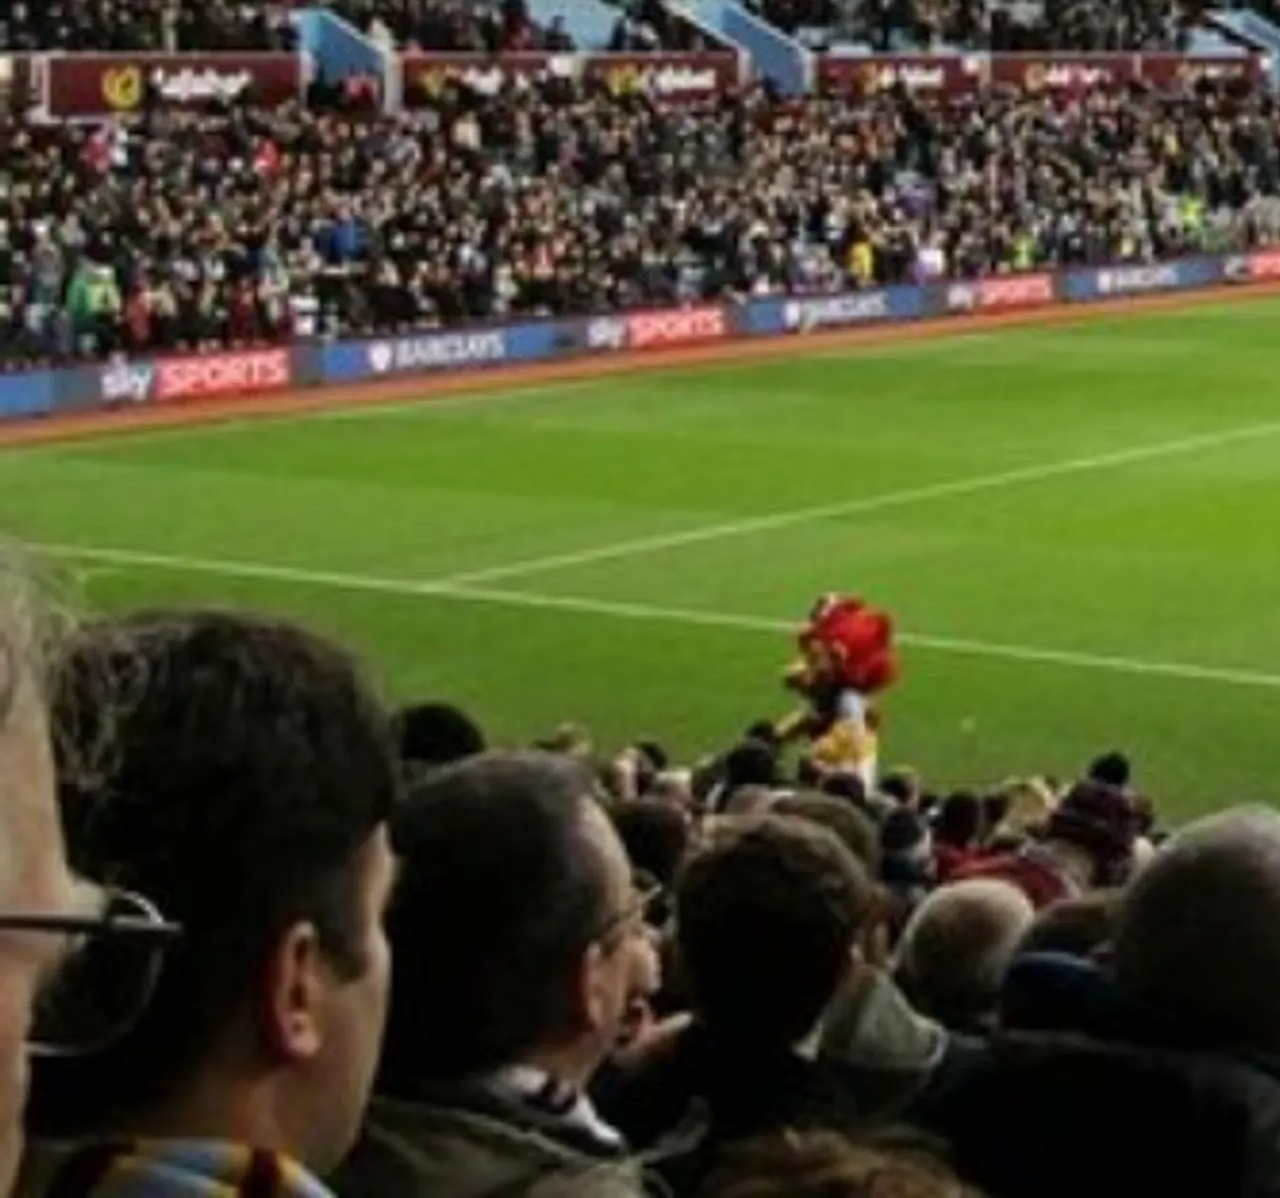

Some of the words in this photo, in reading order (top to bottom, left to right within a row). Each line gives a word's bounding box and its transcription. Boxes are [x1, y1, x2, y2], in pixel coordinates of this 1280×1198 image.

[629, 308, 725, 346] SPORTS
[396, 330, 506, 368] BARCLAYS
[102, 352, 152, 401] sky
[156, 350, 288, 400] SPORTS
